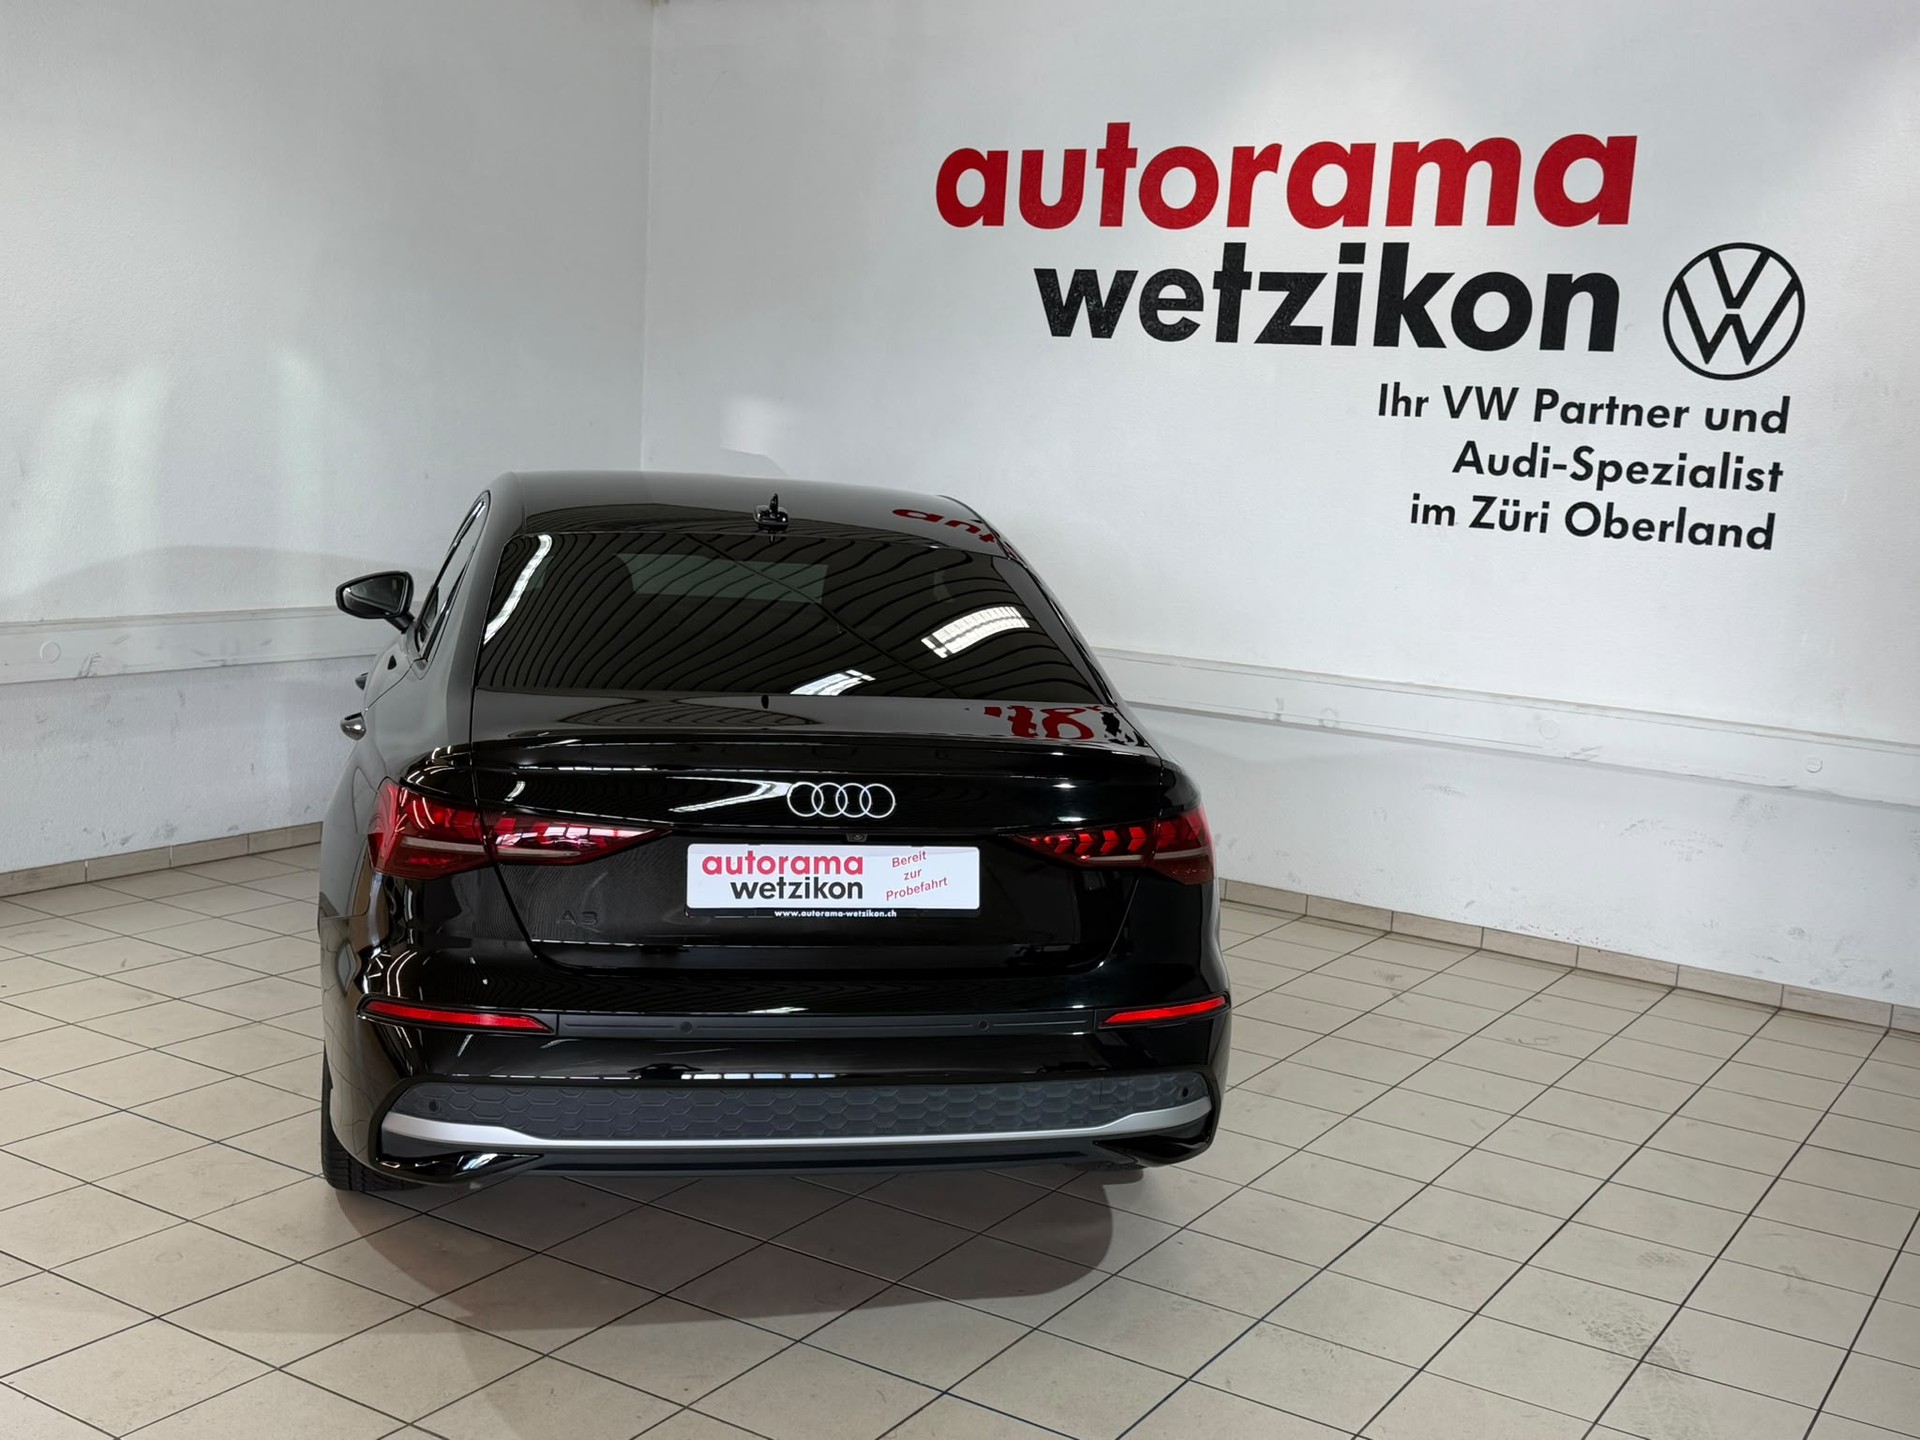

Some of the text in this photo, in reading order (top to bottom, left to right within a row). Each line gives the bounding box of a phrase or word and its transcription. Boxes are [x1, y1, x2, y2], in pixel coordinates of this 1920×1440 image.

[936, 122, 1638, 230] autorama
[1033, 242, 1621, 353] wetzikon
[1378, 382, 1791, 435] Ihr VW Partner und
[1451, 440, 1784, 493] Audi-Spezialist
[1410, 493, 1776, 551] im Züri Oberland
[701, 850, 864, 876] autorama
[892, 850, 927, 868] Bereit
[903, 868, 922, 881] zur
[730, 876, 864, 900] wetzikon
[886, 877, 948, 901] Probefahrt
[774, 909, 897, 918] www.autorama-wetzikon.ch
